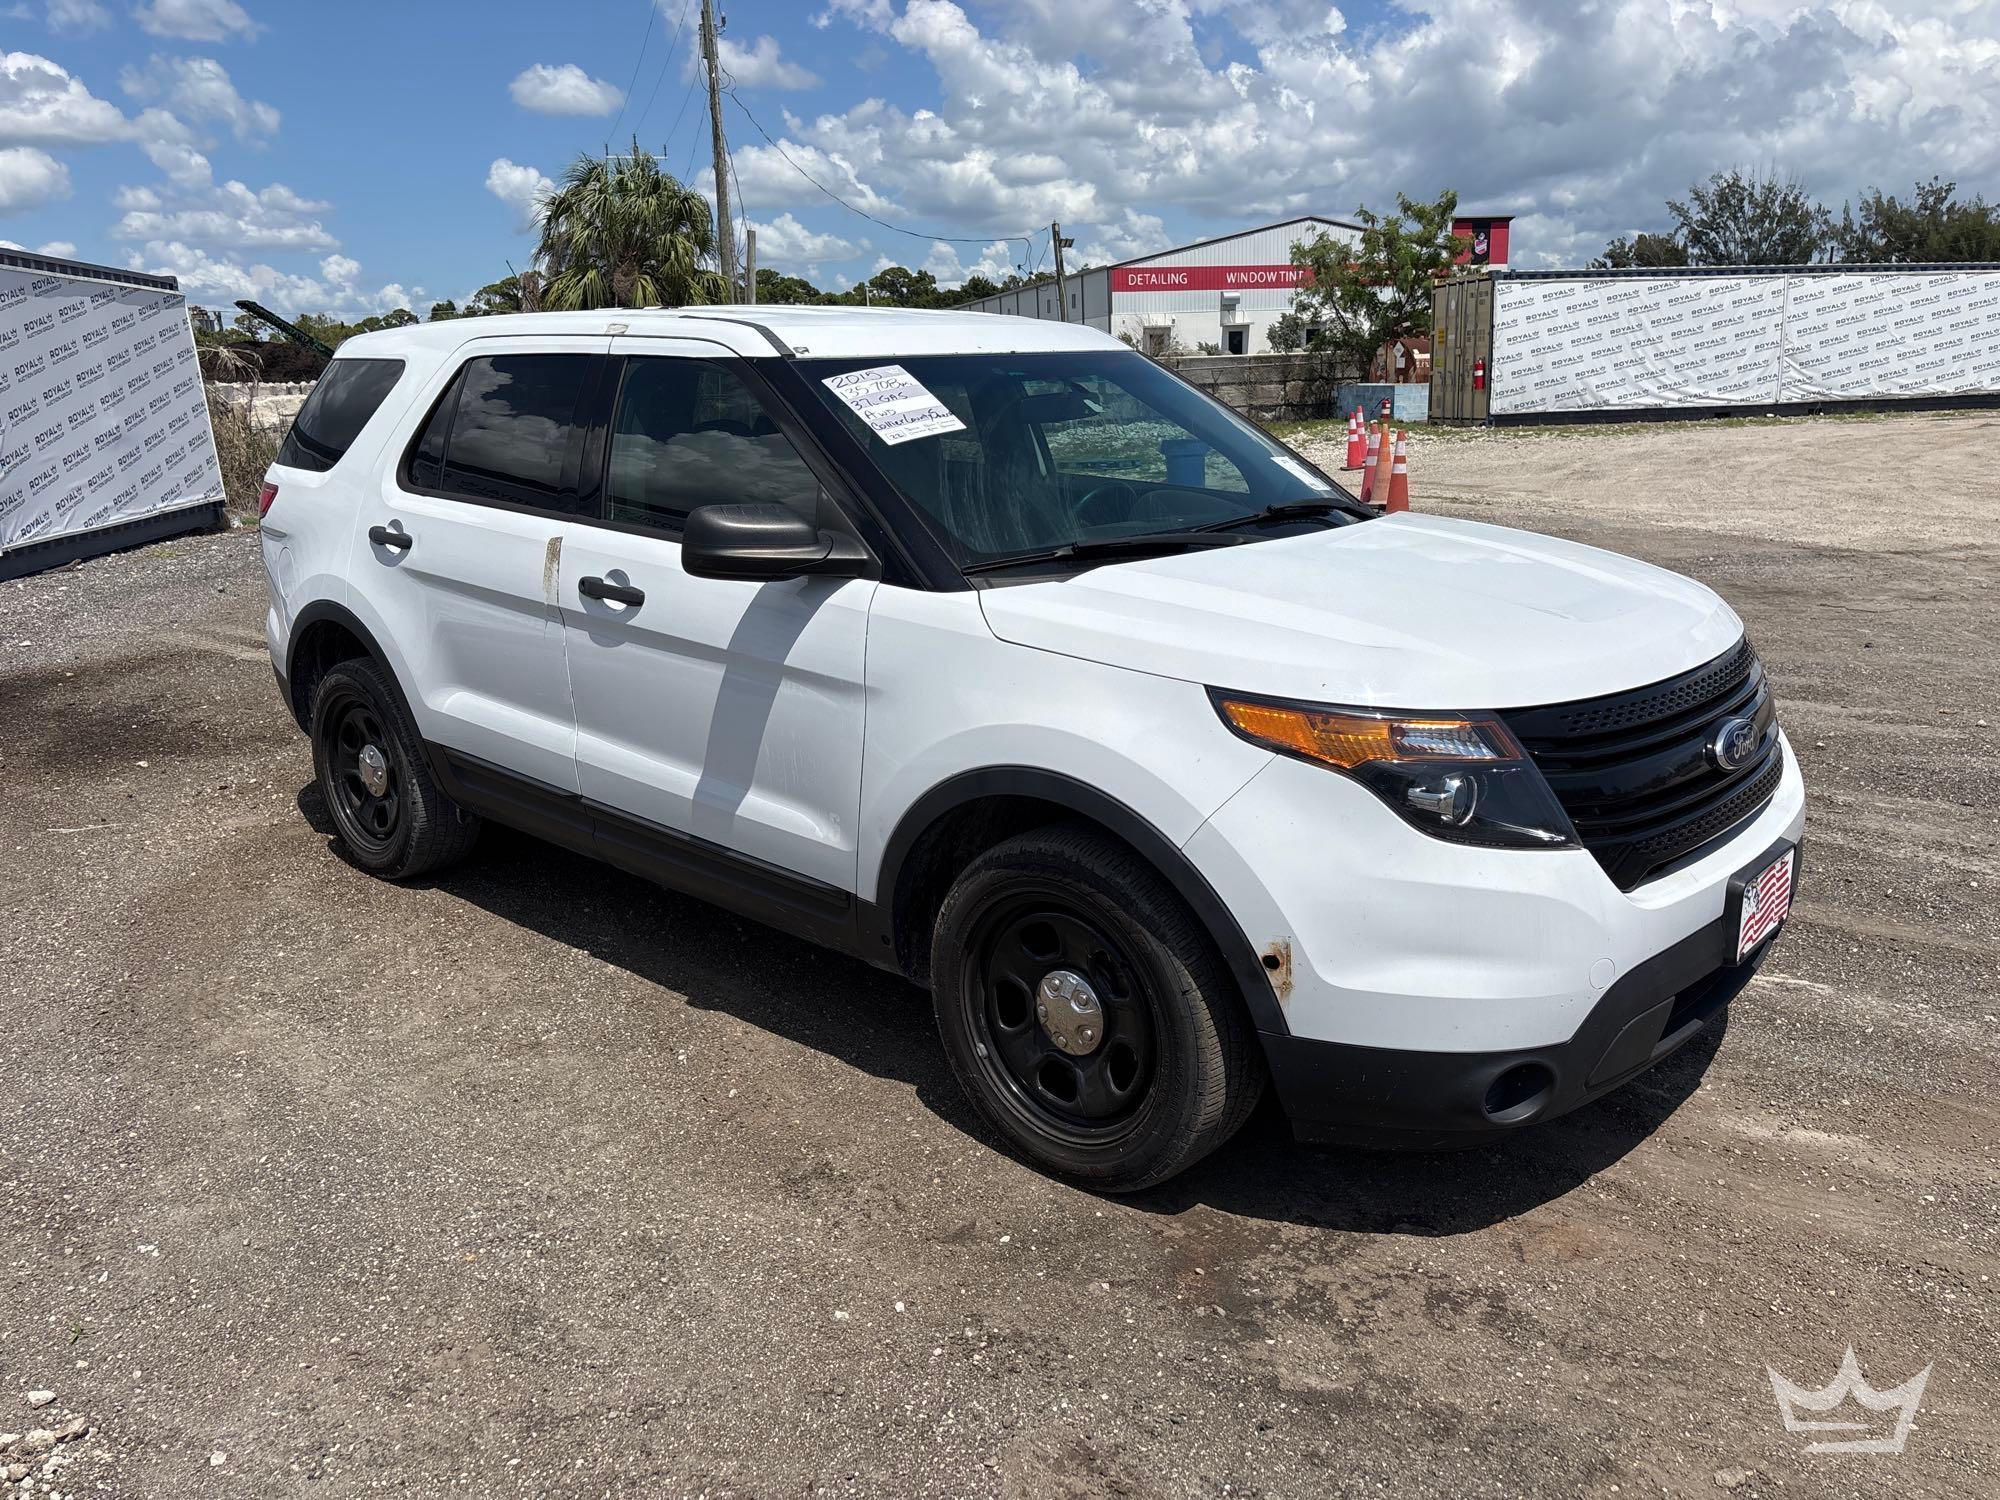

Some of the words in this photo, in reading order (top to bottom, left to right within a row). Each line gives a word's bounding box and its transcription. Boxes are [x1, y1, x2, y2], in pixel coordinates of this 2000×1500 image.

[1128, 272, 1188, 286] DETAILING
[1227, 271, 1277, 284] WINDOW
[1929, 276, 1952, 285] ROYAL
[32, 277, 57, 291] ROYAL
[1647, 282, 1672, 292] ROYAL
[1709, 284, 1733, 294] ROYAL
[1832, 283, 1856, 292] ROYAL
[1542, 289, 1567, 299] ROYAL
[1891, 285, 1915, 294] ROYAL
[1947, 287, 1971, 297] ROYAL
[0, 288, 20, 303] OYAL
[90, 291, 110, 304] ROYAL
[1606, 291, 1632, 301] ROYAL
[1668, 294, 1693, 304] ROYAL
[1732, 296, 1756, 305] ROYAL
[1793, 292, 1818, 302] ROYAL
[1854, 294, 1878, 303] ROYAL
[1501, 300, 1527, 309] ROYAL
[1566, 301, 1592, 311] ROYAL
[1910, 297, 1933, 306] ROYAL
[1968, 298, 1991, 308] ROYAL
[59, 302, 80, 318] ROYAL
[138, 303, 156, 316] ROYAL
[1627, 303, 1653, 313] ROYAL
[1691, 305, 1716, 315] ROYAL
[1752, 307, 1776, 317] ROYAL
[1816, 304, 1840, 313] ROYAL
[1873, 306, 1896, 315] ROYAL
[1931, 308, 1955, 317] ROYAL
[1526, 311, 1550, 321] ROYAL
[1587, 313, 1612, 323] ROYAL
[1650, 315, 1675, 325] ROYAL
[1836, 315, 1859, 325] ROYAL
[24, 315, 47, 333] ROYAL
[112, 315, 130, 330] ROYAL
[1712, 317, 1736, 327] ROYAL
[1894, 317, 1918, 326] ROYAL
[1949, 319, 1973, 329] ROYAL
[159, 325, 176, 338] ROYAL
[1547, 323, 1572, 333] ROYAL
[1610, 325, 1635, 335] ROYAL
[1671, 327, 1696, 337] ROYAL
[1797, 325, 1821, 334] ROYAL
[1857, 326, 1881, 336] ROYAL
[82, 328, 103, 343] ROYAL
[1506, 333, 1532, 343] ROYAL
[1735, 329, 1759, 338] ROYAL
[1913, 329, 1936, 338] ROYAL
[1970, 331, 1994, 340] ROYAL
[133, 337, 151, 351] ROYAL
[1571, 334, 1595, 344] ROYAL
[1630, 336, 1656, 347] ROYAL
[1694, 338, 1720, 348] ROYAL
[1819, 336, 1843, 346] ROYAL
[1876, 338, 1899, 347] ROYAL
[1530, 344, 1555, 355] ROYAL
[1755, 340, 1780, 350] ROYAL
[1934, 340, 1957, 349] ROYAL
[49, 342, 72, 359] ROYAL
[177, 347, 193, 359] ROYAL
[1591, 346, 1616, 357] ROYAL
[1653, 348, 1679, 358] ROYAL
[1714, 350, 1739, 360] ROYAL
[1838, 347, 1862, 357] ROYAL
[1897, 349, 1921, 358] ROYAL
[1952, 351, 1975, 360] ROYAL
[107, 351, 125, 366] ROYAL
[1551, 356, 1577, 366] ROYAL
[1613, 358, 1638, 368] ROYAL
[1799, 357, 1824, 367] ROYAL
[1859, 359, 1883, 367] ROYAL
[14, 359, 38, 377] ROYAL
[152, 360, 170, 374] ROYAL
[1674, 359, 1699, 370] ROYAL
[1737, 361, 1760, 371] ROYAL
[1916, 361, 1939, 370] ROYAL
[1972, 362, 1995, 371] ROYAL
[76, 366, 98, 383] ROYAL
[1511, 366, 1536, 376] ROYAL
[1575, 367, 1600, 378] ROYAL
[1634, 370, 1659, 380] ROYAL
[1697, 371, 1722, 381] ROYAL
[1822, 368, 1845, 378] ROYAL
[1878, 370, 1902, 379] ROYAL
[1936, 371, 1959, 381] ROYAL
[128, 374, 146, 389] ROYAL
[831, 371, 882, 388] 2015
[1534, 377, 1560, 387] ROYAL
[1595, 379, 1619, 389] ROYAL
[1840, 380, 1864, 389] ROYAL
[1899, 380, 1923, 389] ROYAL
[173, 380, 190, 394] ROYAL
[1657, 381, 1682, 390] ROYAL
[1717, 382, 1742, 392] ROYAL
[1955, 382, 1978, 391] ROYAL
[42, 383, 65, 401] ROYAL
[1554, 389, 1580, 399] ROYAL
[1617, 390, 1642, 400] ROYAL
[100, 390, 120, 406] ROYAL
[149, 395, 167, 409] ROYAL
[879, 392, 908, 403] GAS
[191, 400, 205, 413] ROYA
[1514, 399, 1540, 409] ROYAL
[8, 403, 32, 421] ROYAL
[68, 407, 90, 424] ROYAL
[124, 410, 142, 426] ROYAL
[168, 414, 186, 429] ROYAL
[35, 427, 57, 445] ROYAL
[94, 428, 116, 445] ROYAL
[144, 431, 162, 447] ROYAL
[188, 433, 205, 447] ROYAL
[0, 449, 23, 468] ROYAL
[62, 448, 85, 466] ROYAL
[118, 450, 137, 466] ROYAL
[165, 450, 182, 465] ROYAL
[29, 470, 52, 490] ROYAL
[88, 470, 109, 488] ROYAL
[140, 469, 158, 485] ROYAL
[184, 468, 200, 484] ROYAL
[161, 487, 178, 503] ROYAL
[203, 484, 218, 499] ROYAL
[55, 493, 77, 511] ROYAL
[113, 488, 132, 506] ROYAL
[0, 493, 17, 512] OYAL
[84, 510, 104, 528] ROYAL
[20, 517, 44, 537] ROYAL
[1733, 725, 1755, 759] Ford
